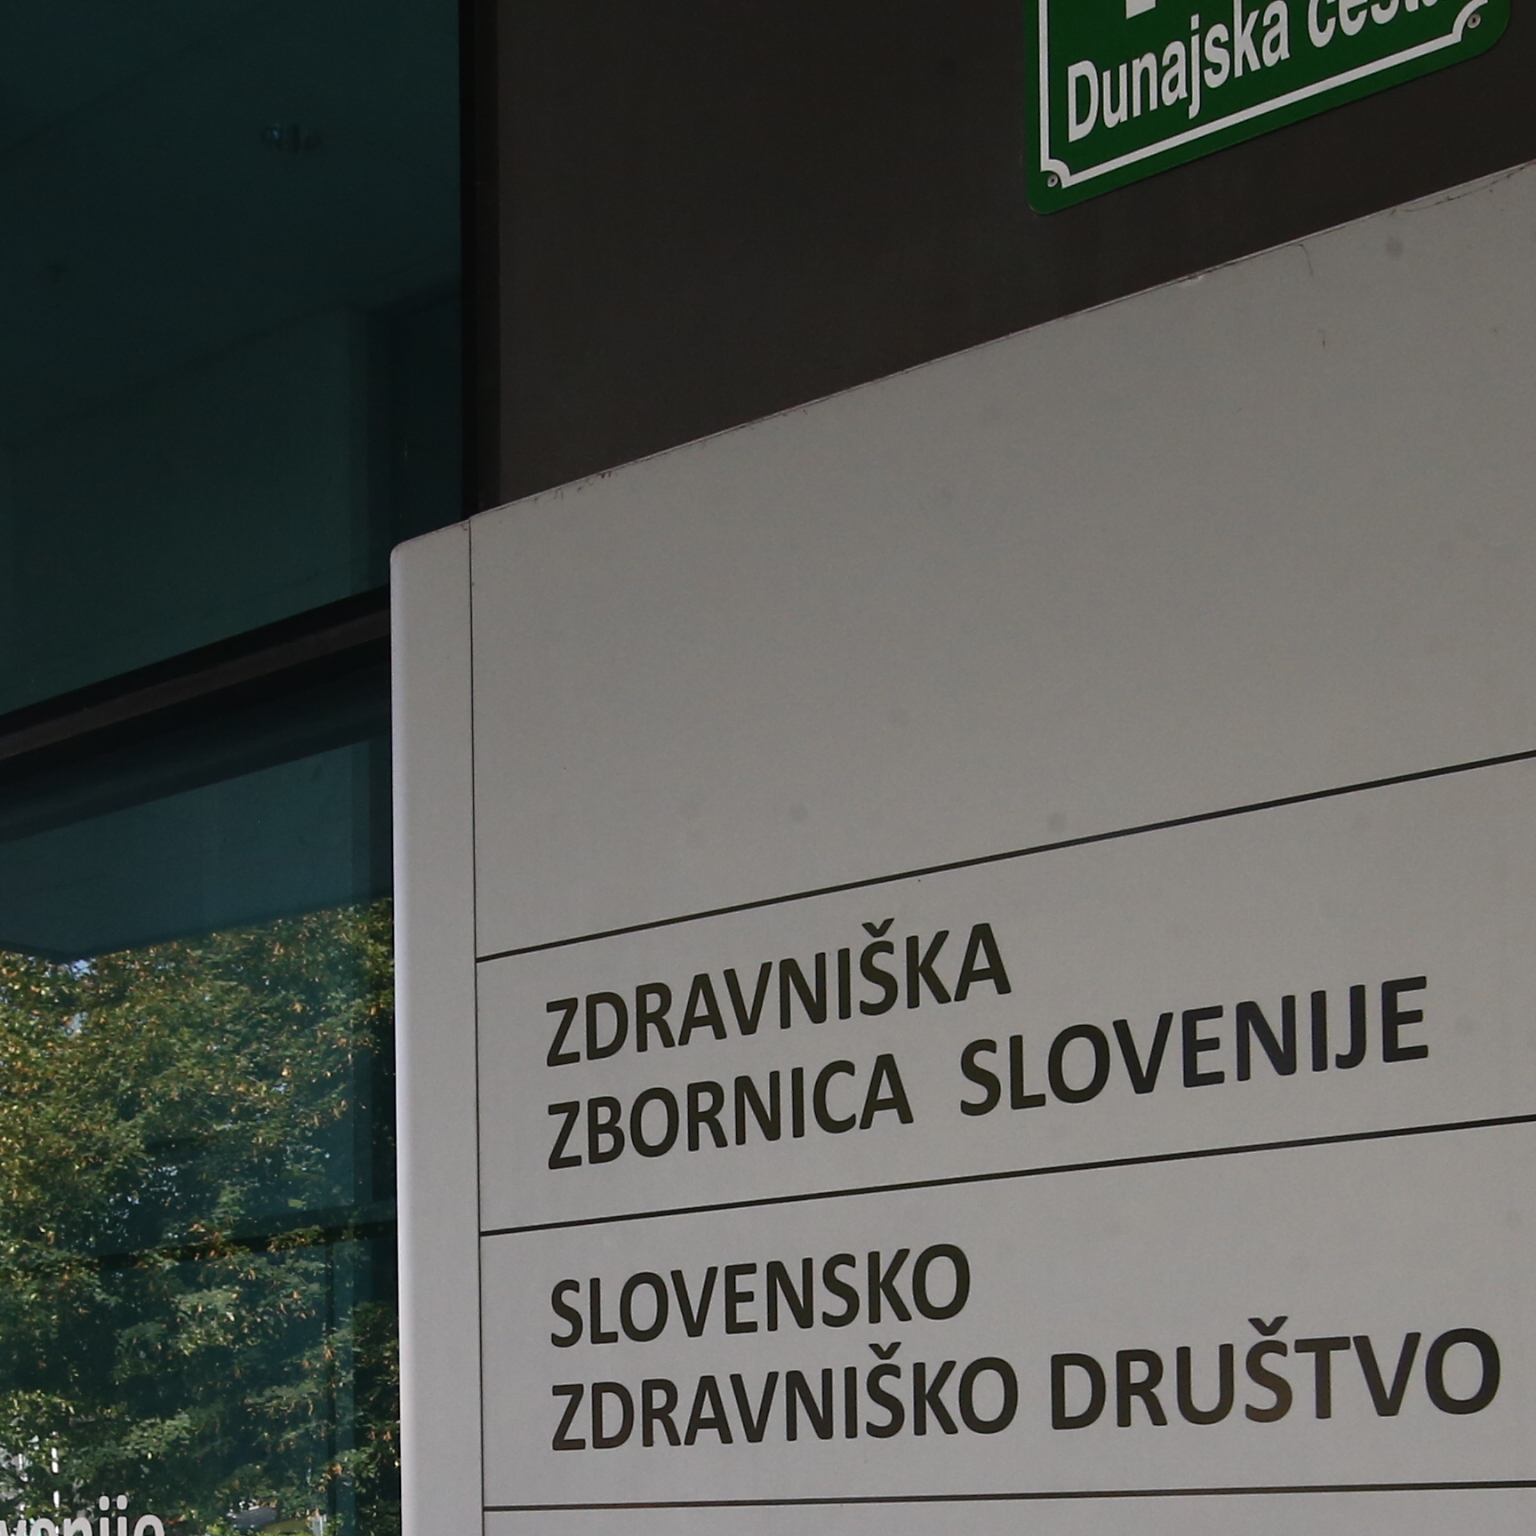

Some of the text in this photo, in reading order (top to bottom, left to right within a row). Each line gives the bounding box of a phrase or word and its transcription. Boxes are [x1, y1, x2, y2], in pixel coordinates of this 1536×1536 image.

[1068, 0, 1290, 141] Dunajska
[545, 918, 1012, 1067] ZDRAVNIŠKA
[547, 976, 1430, 1170] ZBORNICA SLOVENIJE
[550, 1243, 972, 1348] SLOVENSKO
[552, 1316, 1501, 1452] ZDRAVNIŠKO DRUŠTVO
